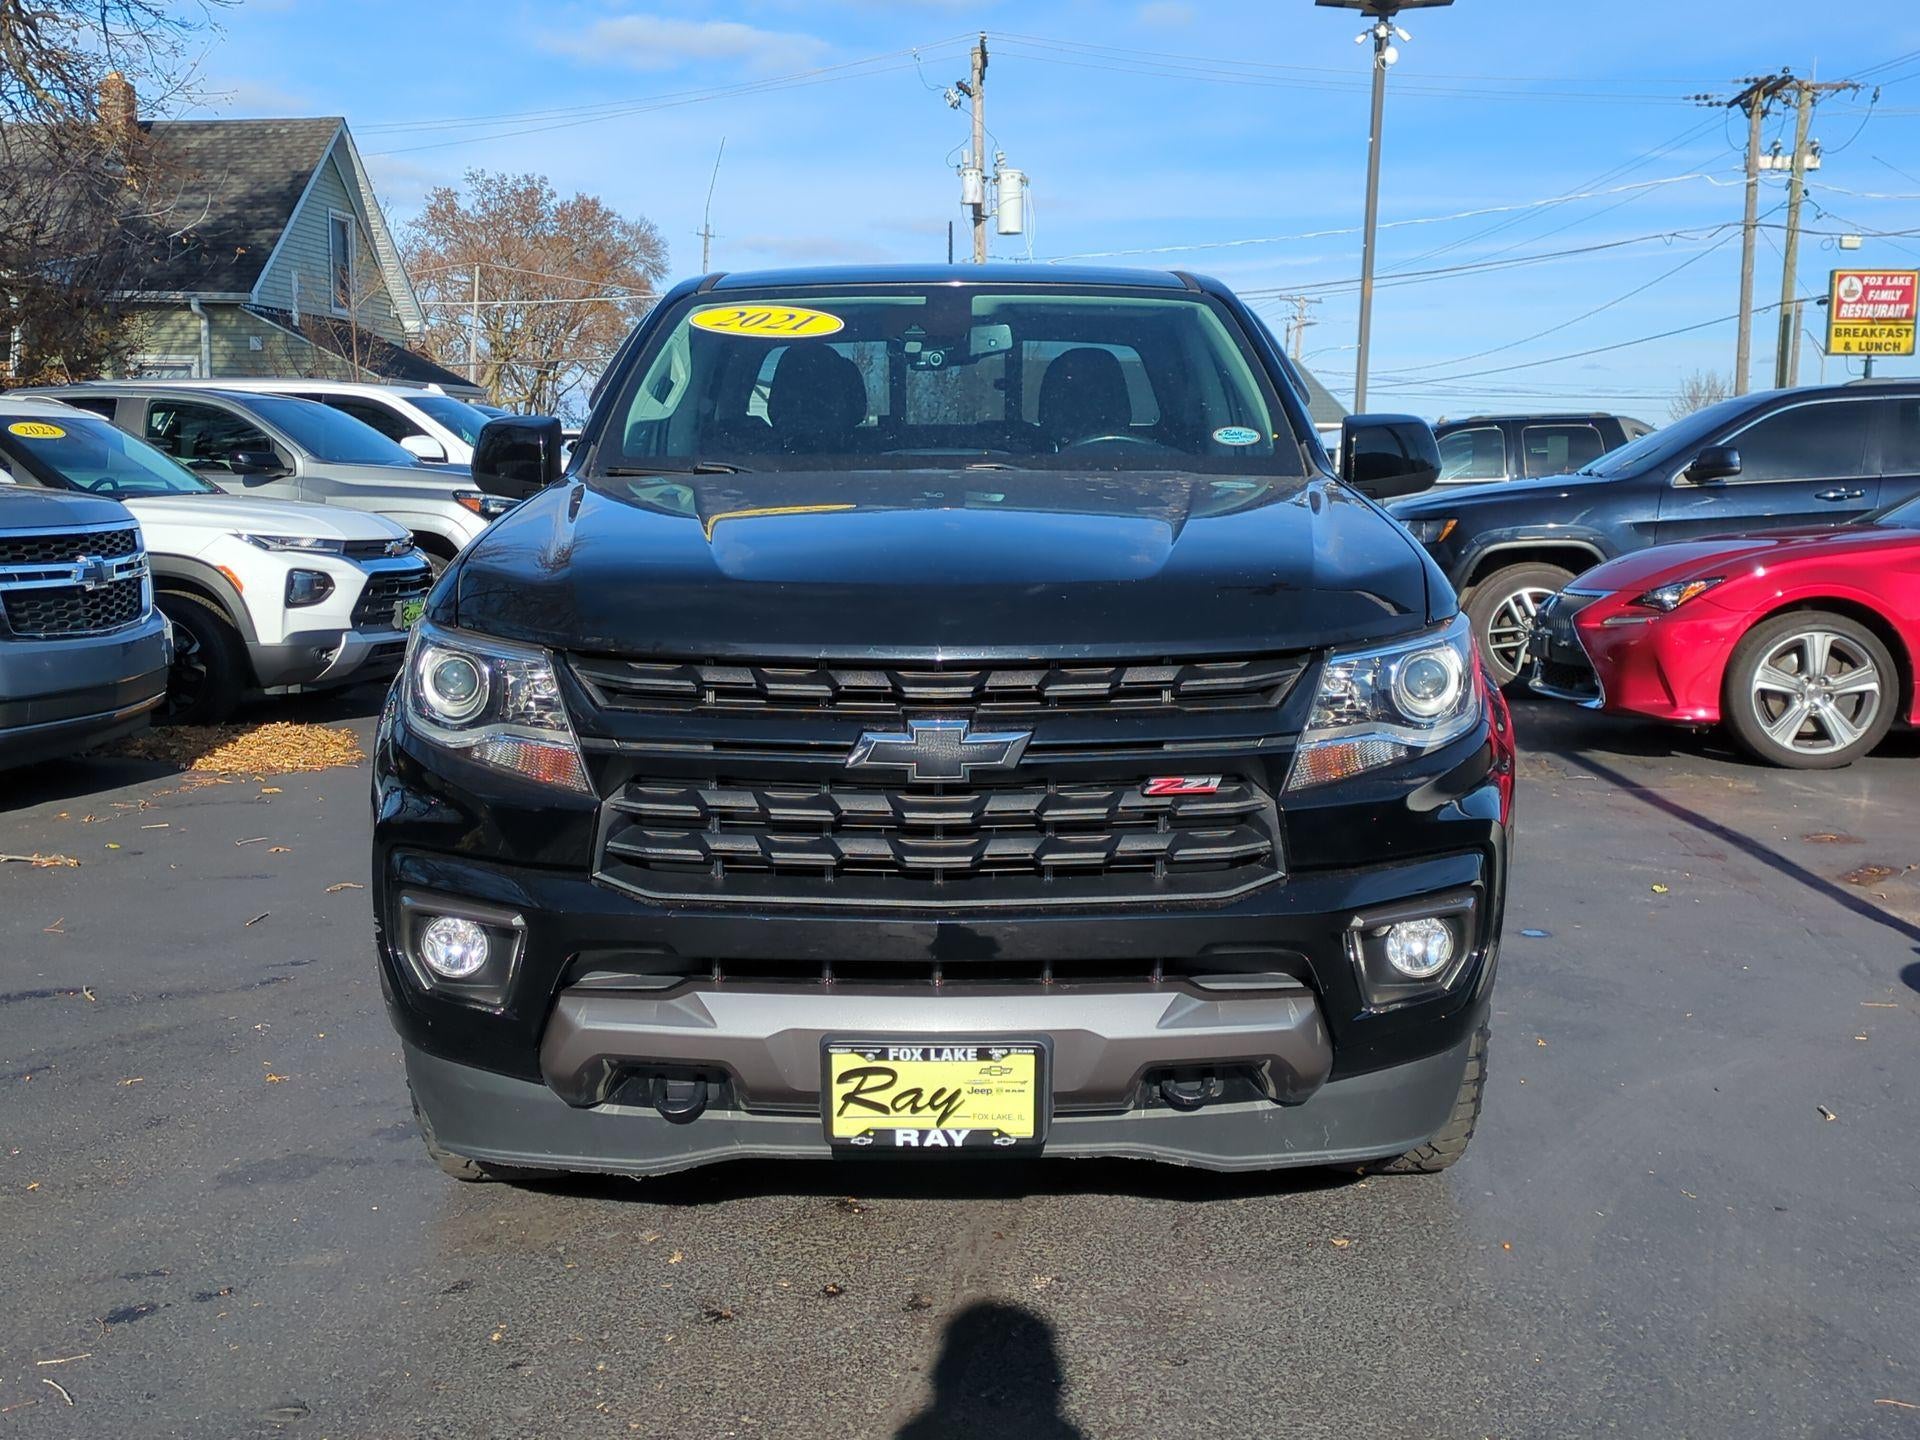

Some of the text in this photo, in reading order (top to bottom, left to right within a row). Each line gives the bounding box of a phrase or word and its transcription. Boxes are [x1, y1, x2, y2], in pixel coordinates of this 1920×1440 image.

[1863, 276, 1912, 286] FOX LAKE
[1867, 290, 1903, 301] FAMILY
[1839, 303, 1910, 318] RESTAURANT
[714, 311, 820, 331] 2021
[1834, 328, 1912, 338] BREAKFAST
[1844, 341, 1901, 352] & LUNCH
[20, 425, 57, 435] 2023
[1143, 777, 1222, 795] Z71
[888, 1048, 978, 1061] FOX LAKE
[836, 1066, 965, 1128] Ray
[967, 1087, 993, 1096] Jeep
[972, 1113, 989, 1121] FOX
[1017, 1113, 1025, 1121] IL
[895, 1129, 972, 1147] RAY
